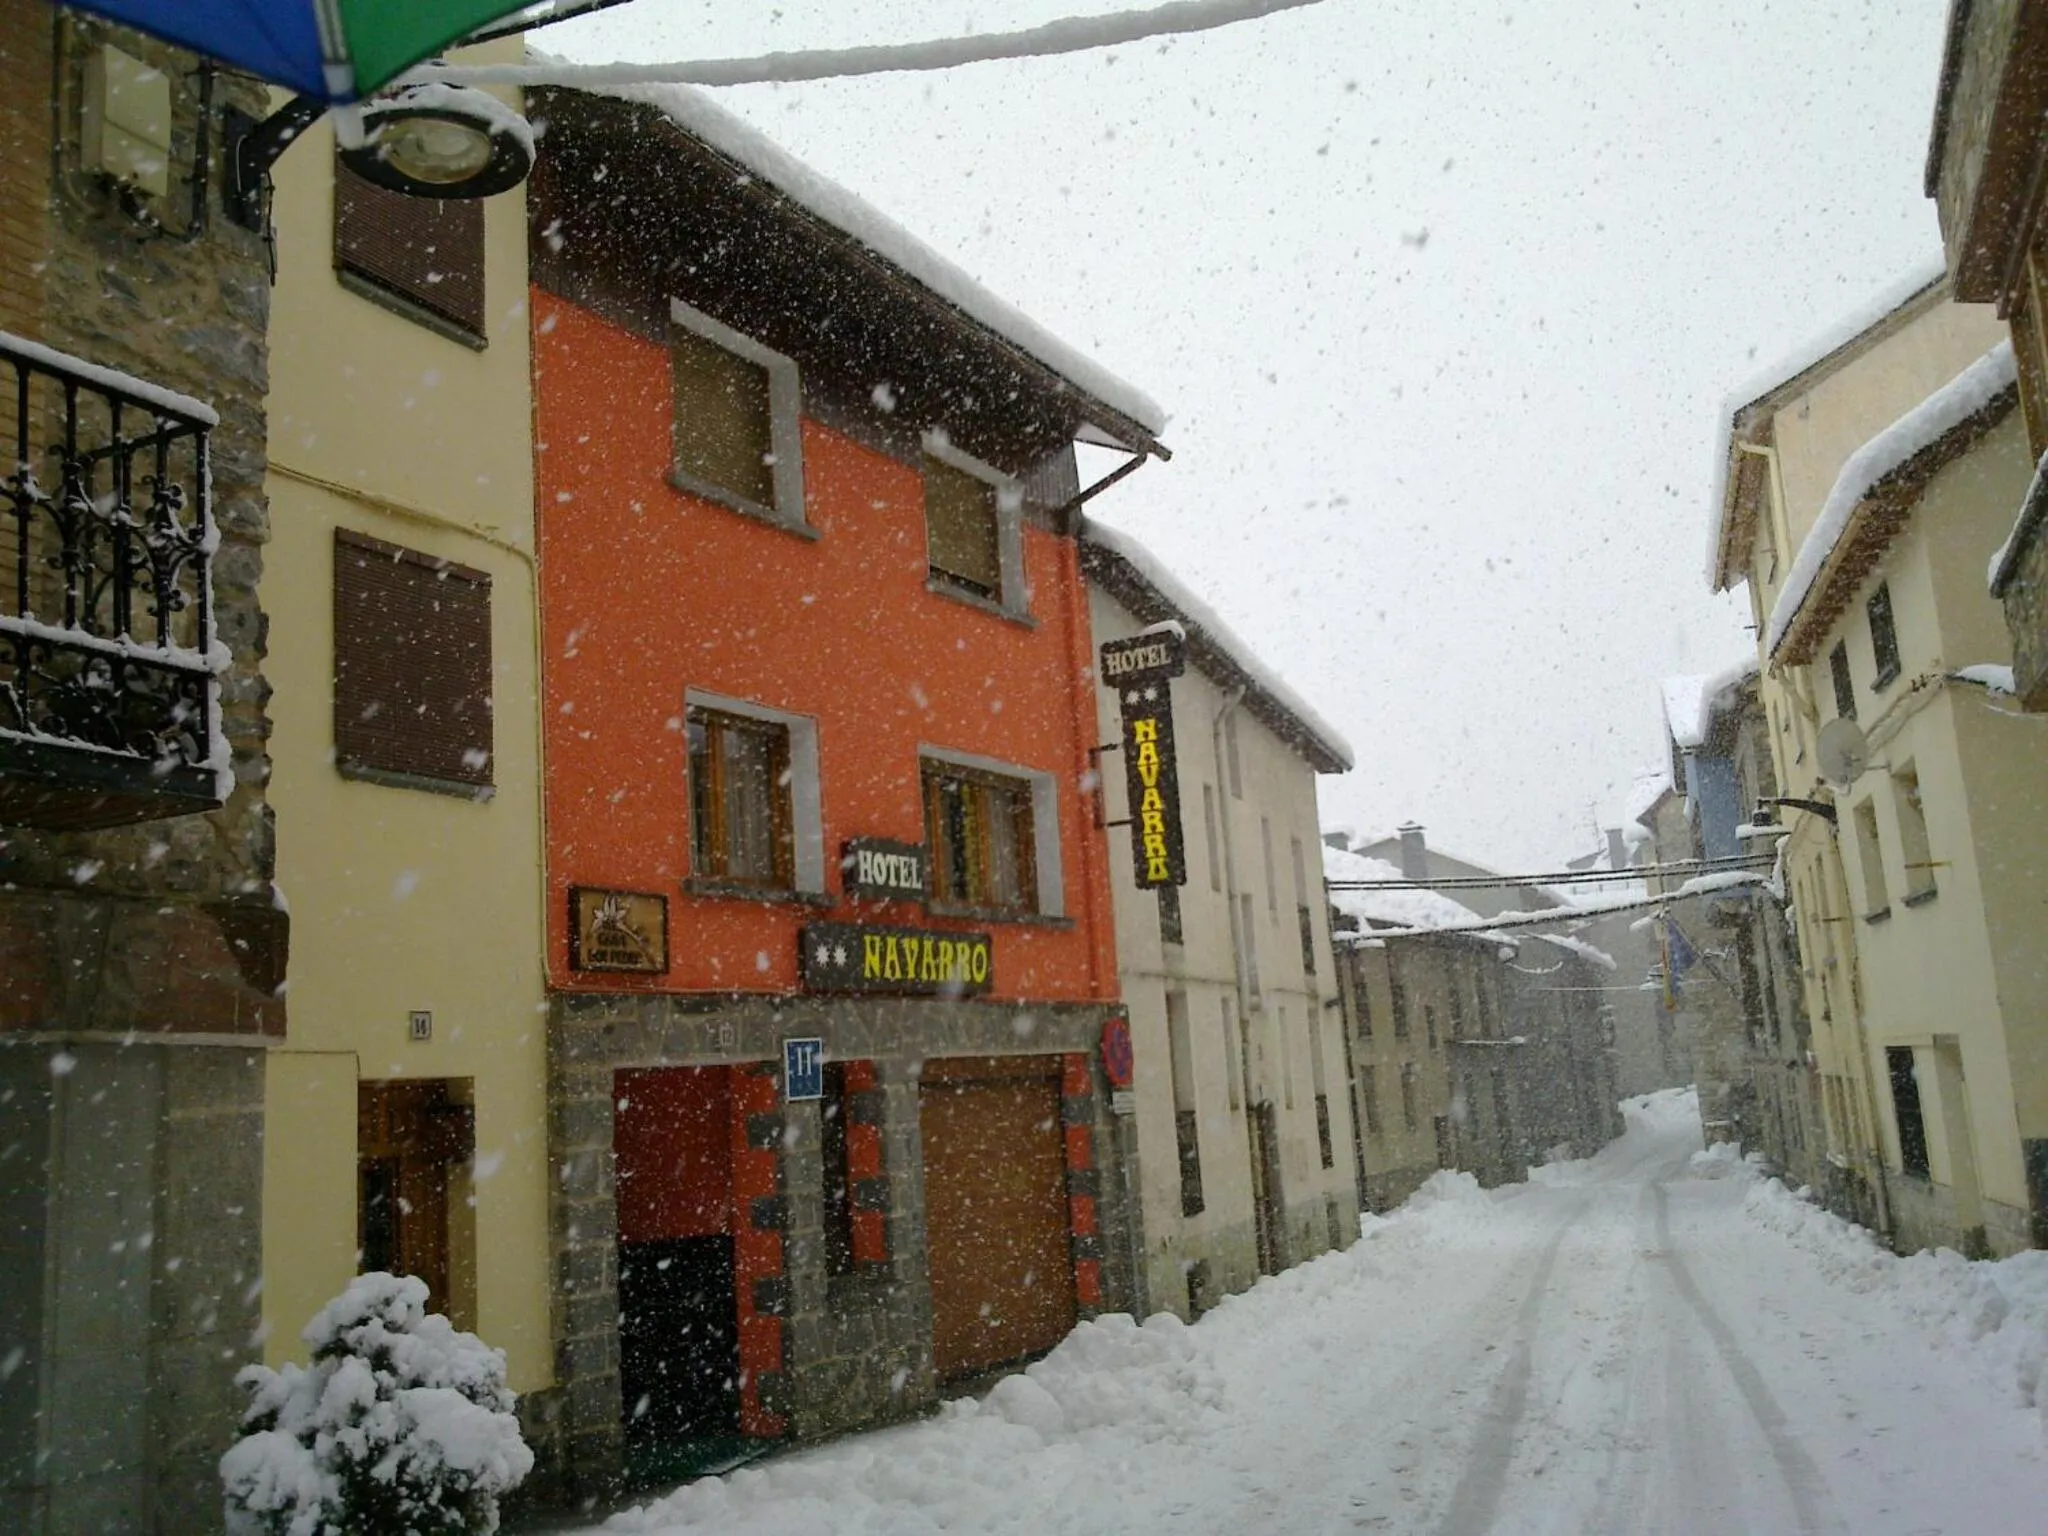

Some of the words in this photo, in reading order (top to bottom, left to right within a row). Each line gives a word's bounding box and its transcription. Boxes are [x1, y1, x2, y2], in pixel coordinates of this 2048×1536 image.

[1105, 644, 1172, 677] HOTEL
[857, 850, 923, 890] HOTEL
[863, 934, 988, 984] NAVARRO
